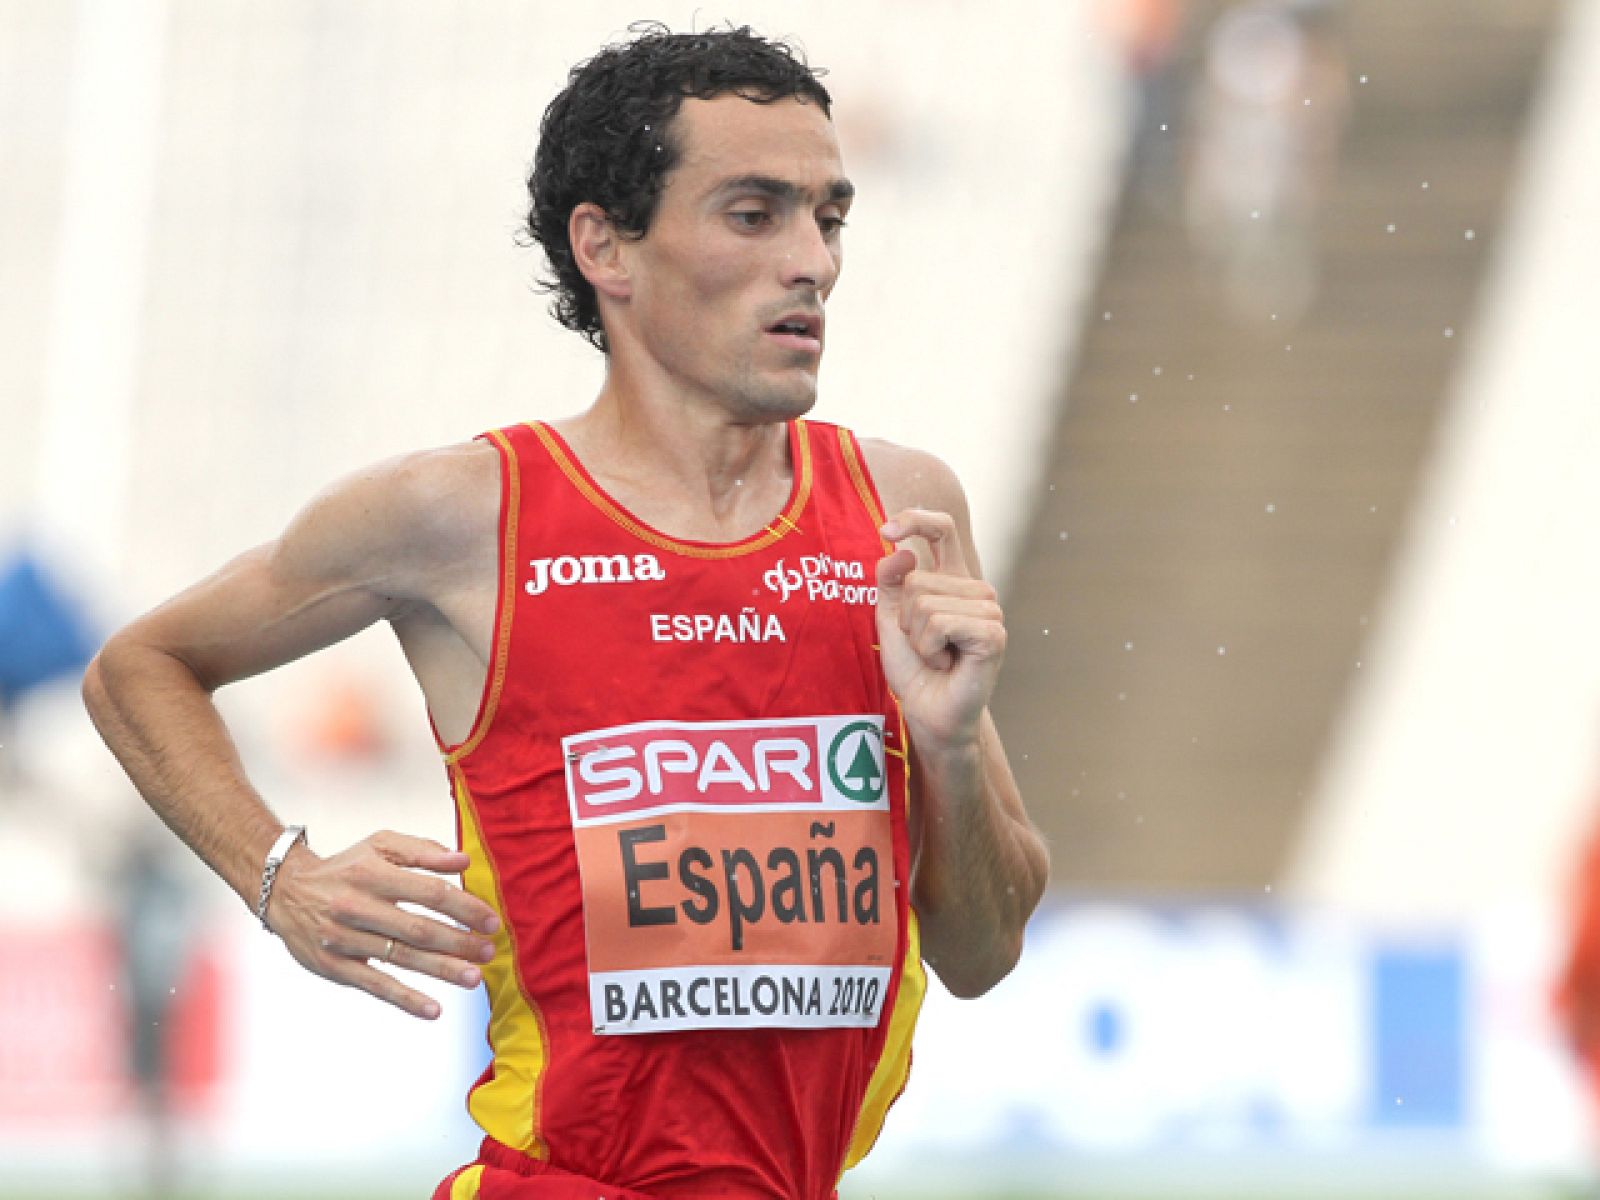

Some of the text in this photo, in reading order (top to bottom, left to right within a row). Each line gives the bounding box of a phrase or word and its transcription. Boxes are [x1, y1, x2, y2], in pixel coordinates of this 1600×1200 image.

[650, 606, 786, 643] ESPAÑA
[579, 737, 814, 806] SPAR
[617, 820, 881, 951] España
[604, 975, 881, 1022] BARCELONA 2010
